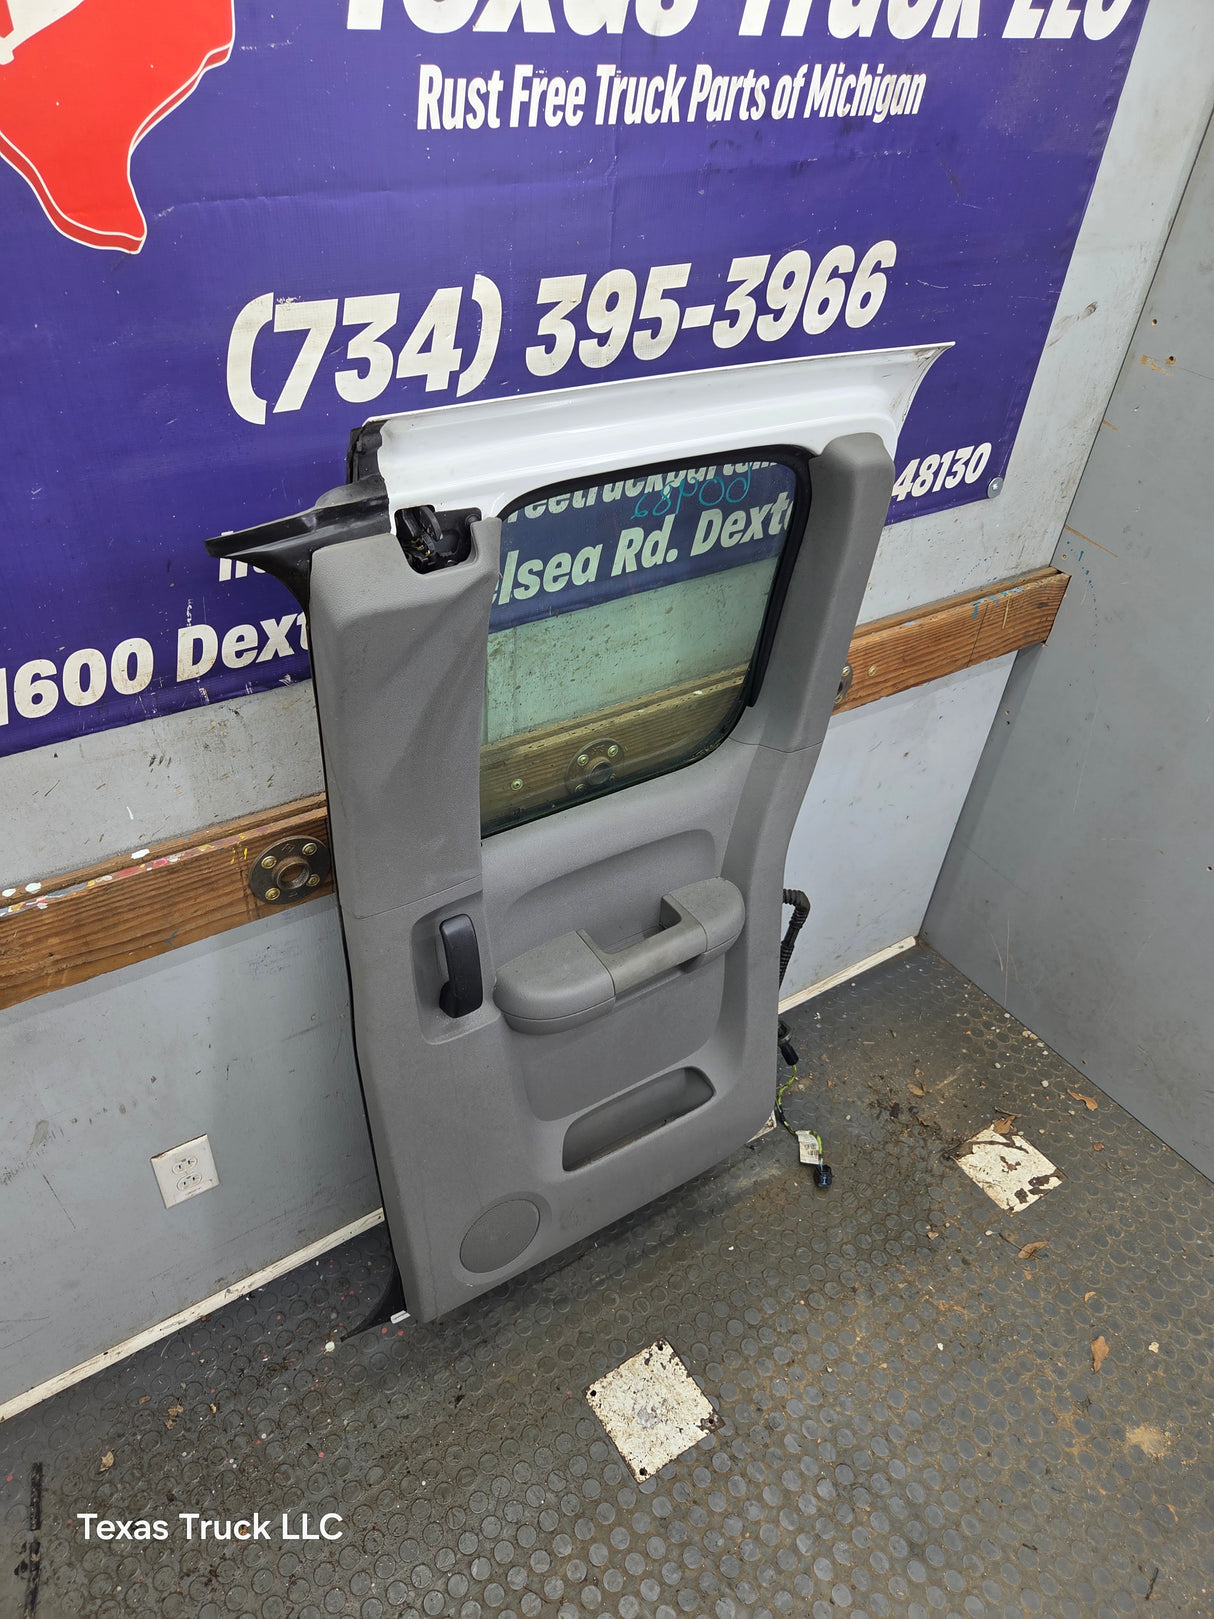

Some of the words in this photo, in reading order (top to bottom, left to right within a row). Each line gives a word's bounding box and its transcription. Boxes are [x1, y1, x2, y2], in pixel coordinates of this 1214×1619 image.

[417, 64, 503, 130] Rust
[510, 64, 587, 128] Free
[595, 63, 687, 126] Truck
[687, 63, 769, 122] Parts
[770, 63, 807, 120] of
[803, 61, 927, 123] Michigan
[226, 273, 501, 425] (734)
[525, 239, 898, 377] 395-3966
[491, 543, 604, 607] lsea
[610, 513, 679, 577] Rd.
[891, 442, 993, 502] 48130
